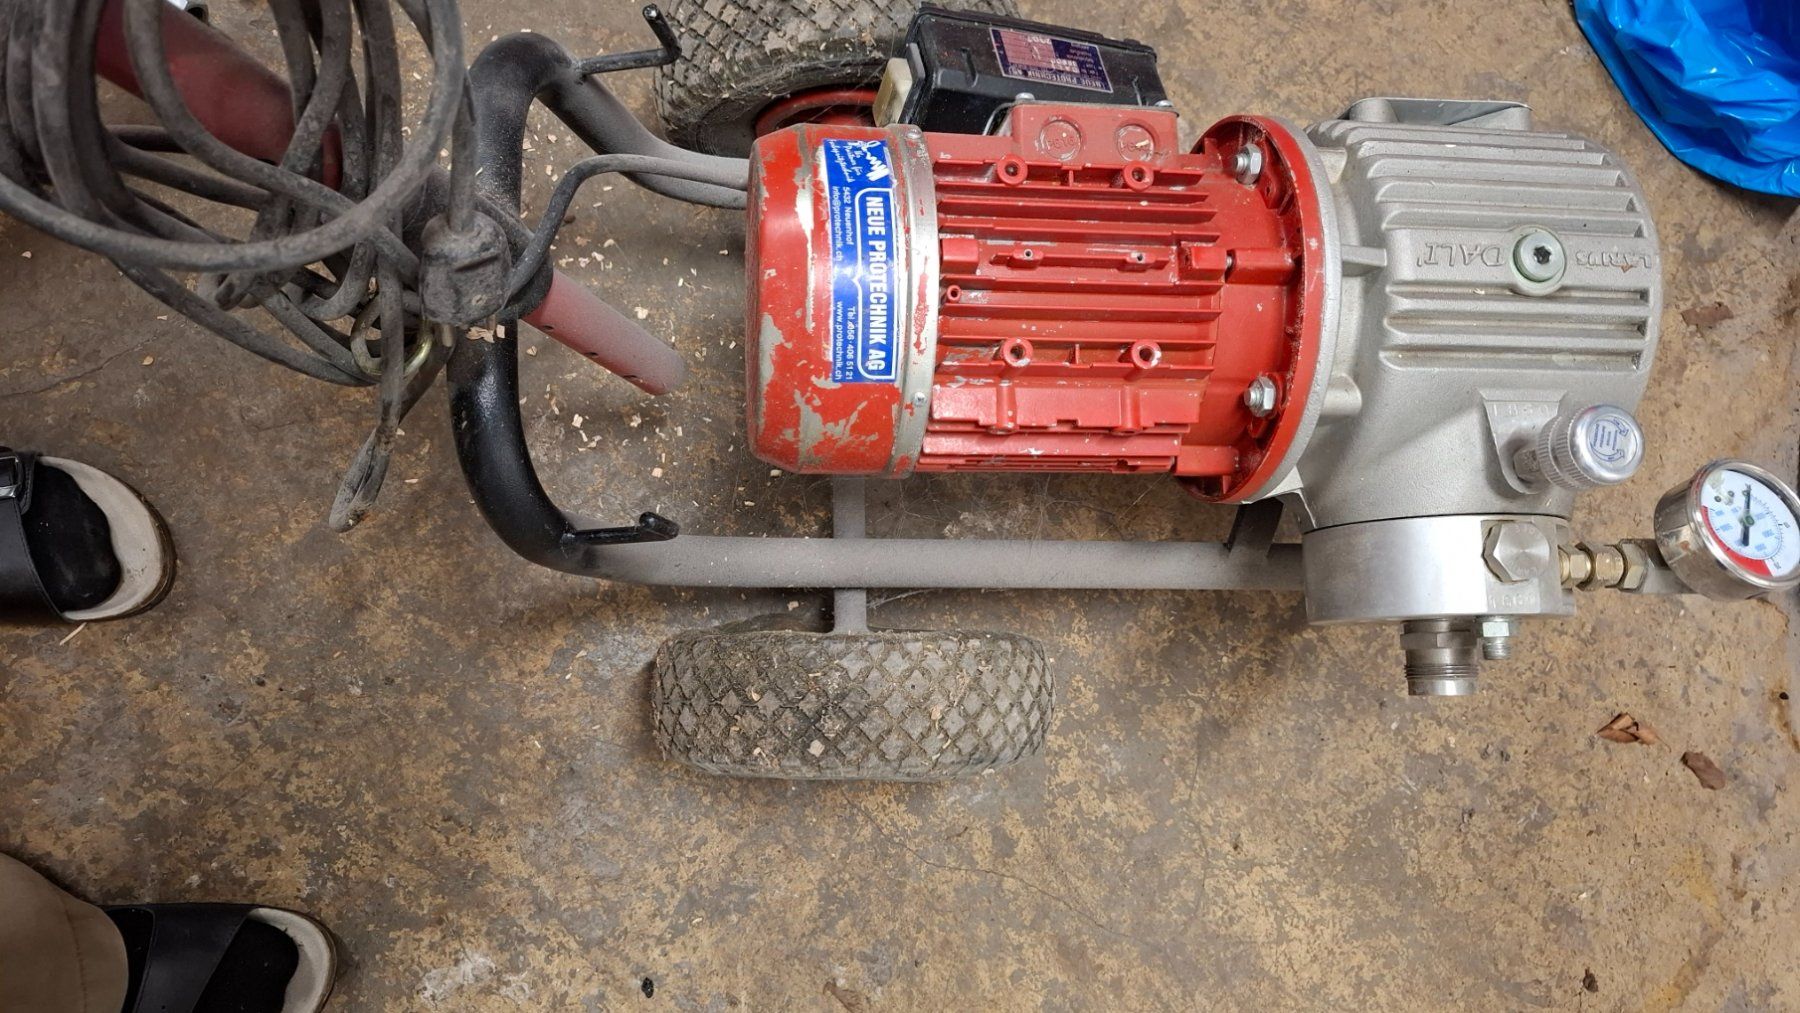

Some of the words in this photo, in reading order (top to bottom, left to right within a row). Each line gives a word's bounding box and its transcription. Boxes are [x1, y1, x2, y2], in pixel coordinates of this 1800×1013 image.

[842, 186, 852, 204] 5432
[832, 185, 844, 262] info@protechnik.ch
[844, 206, 855, 245] Neuenhof
[866, 196, 886, 236] NEUE
[1576, 249, 1652, 270] LARIUS
[868, 240, 888, 345] PROTECHNIK
[834, 300, 845, 380] www.protechnik.ch
[845, 361, 854, 370] 51
[845, 371, 854, 380] 21
[867, 348, 886, 372] AG
